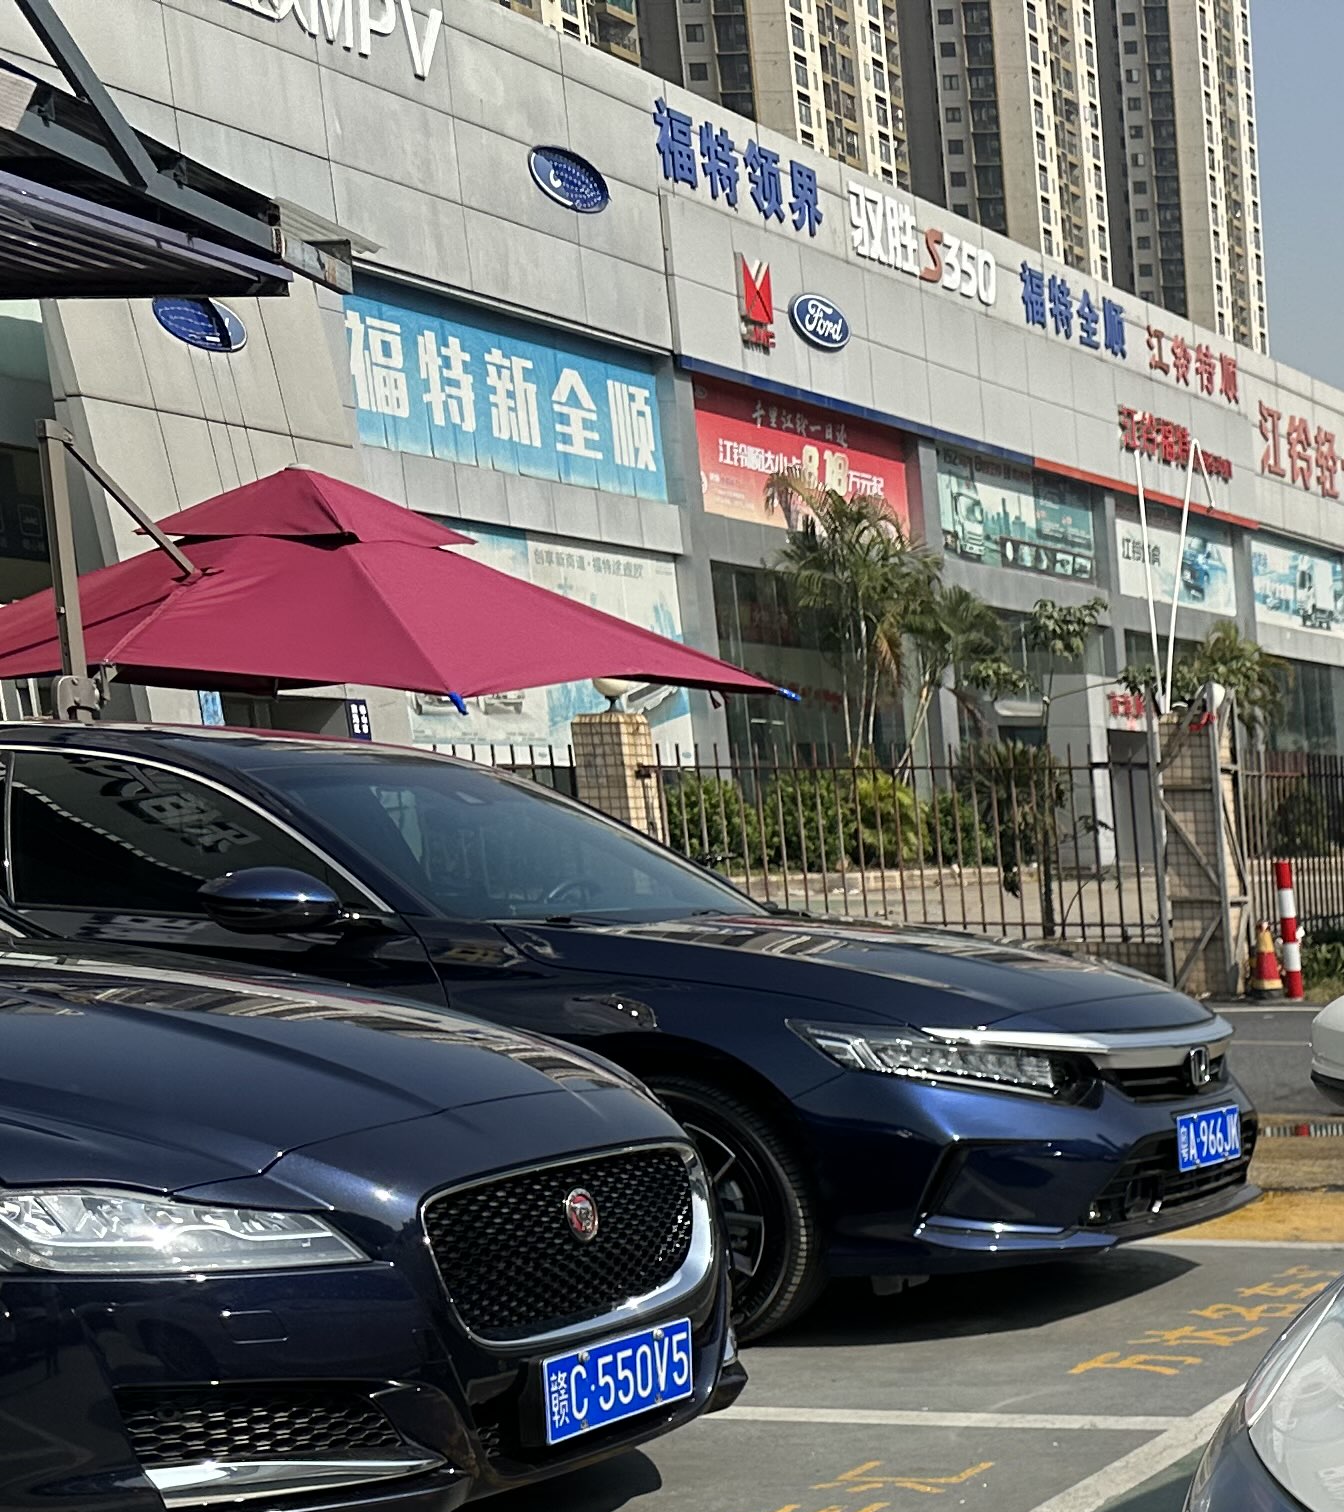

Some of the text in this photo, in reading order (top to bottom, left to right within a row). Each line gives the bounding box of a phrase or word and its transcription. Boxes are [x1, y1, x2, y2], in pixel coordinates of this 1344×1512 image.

[653, 97, 823, 238] 福特领界
[848, 180, 996, 306] 驭胜S350
[805, 299, 843, 341] Ford
[1019, 261, 1127, 359] 福特全顺
[344, 310, 656, 472] 福特新全顺
[1146, 326, 1239, 405] 江铃特顺
[550, 1331, 688, 1428] 赣C·550V5
